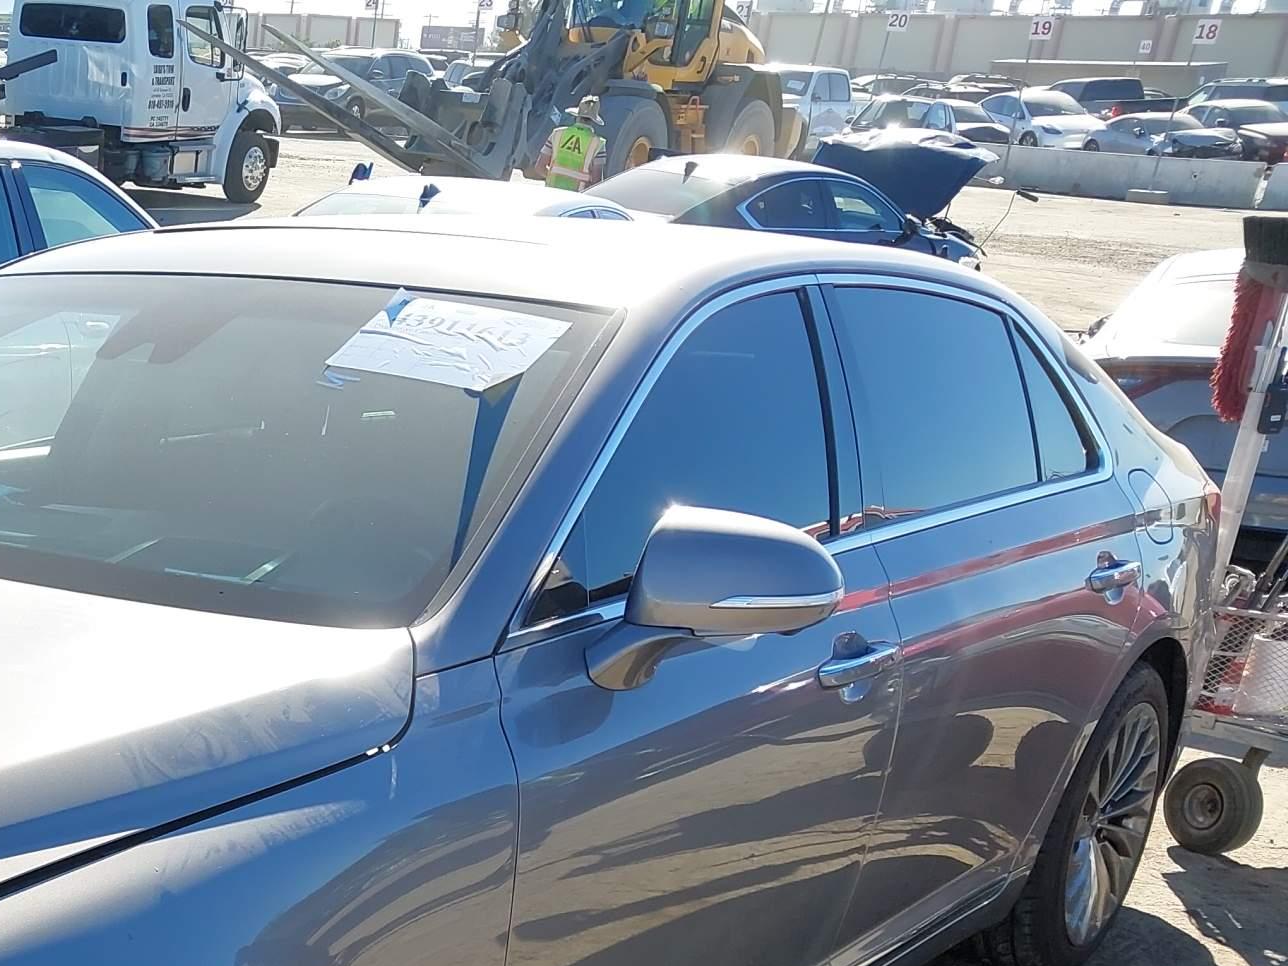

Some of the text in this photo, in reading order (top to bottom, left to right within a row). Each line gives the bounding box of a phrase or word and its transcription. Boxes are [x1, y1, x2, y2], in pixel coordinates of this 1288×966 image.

[888, 13, 908, 28] 20
[1031, 20, 1052, 36] 19
[1194, 23, 1218, 40] 18
